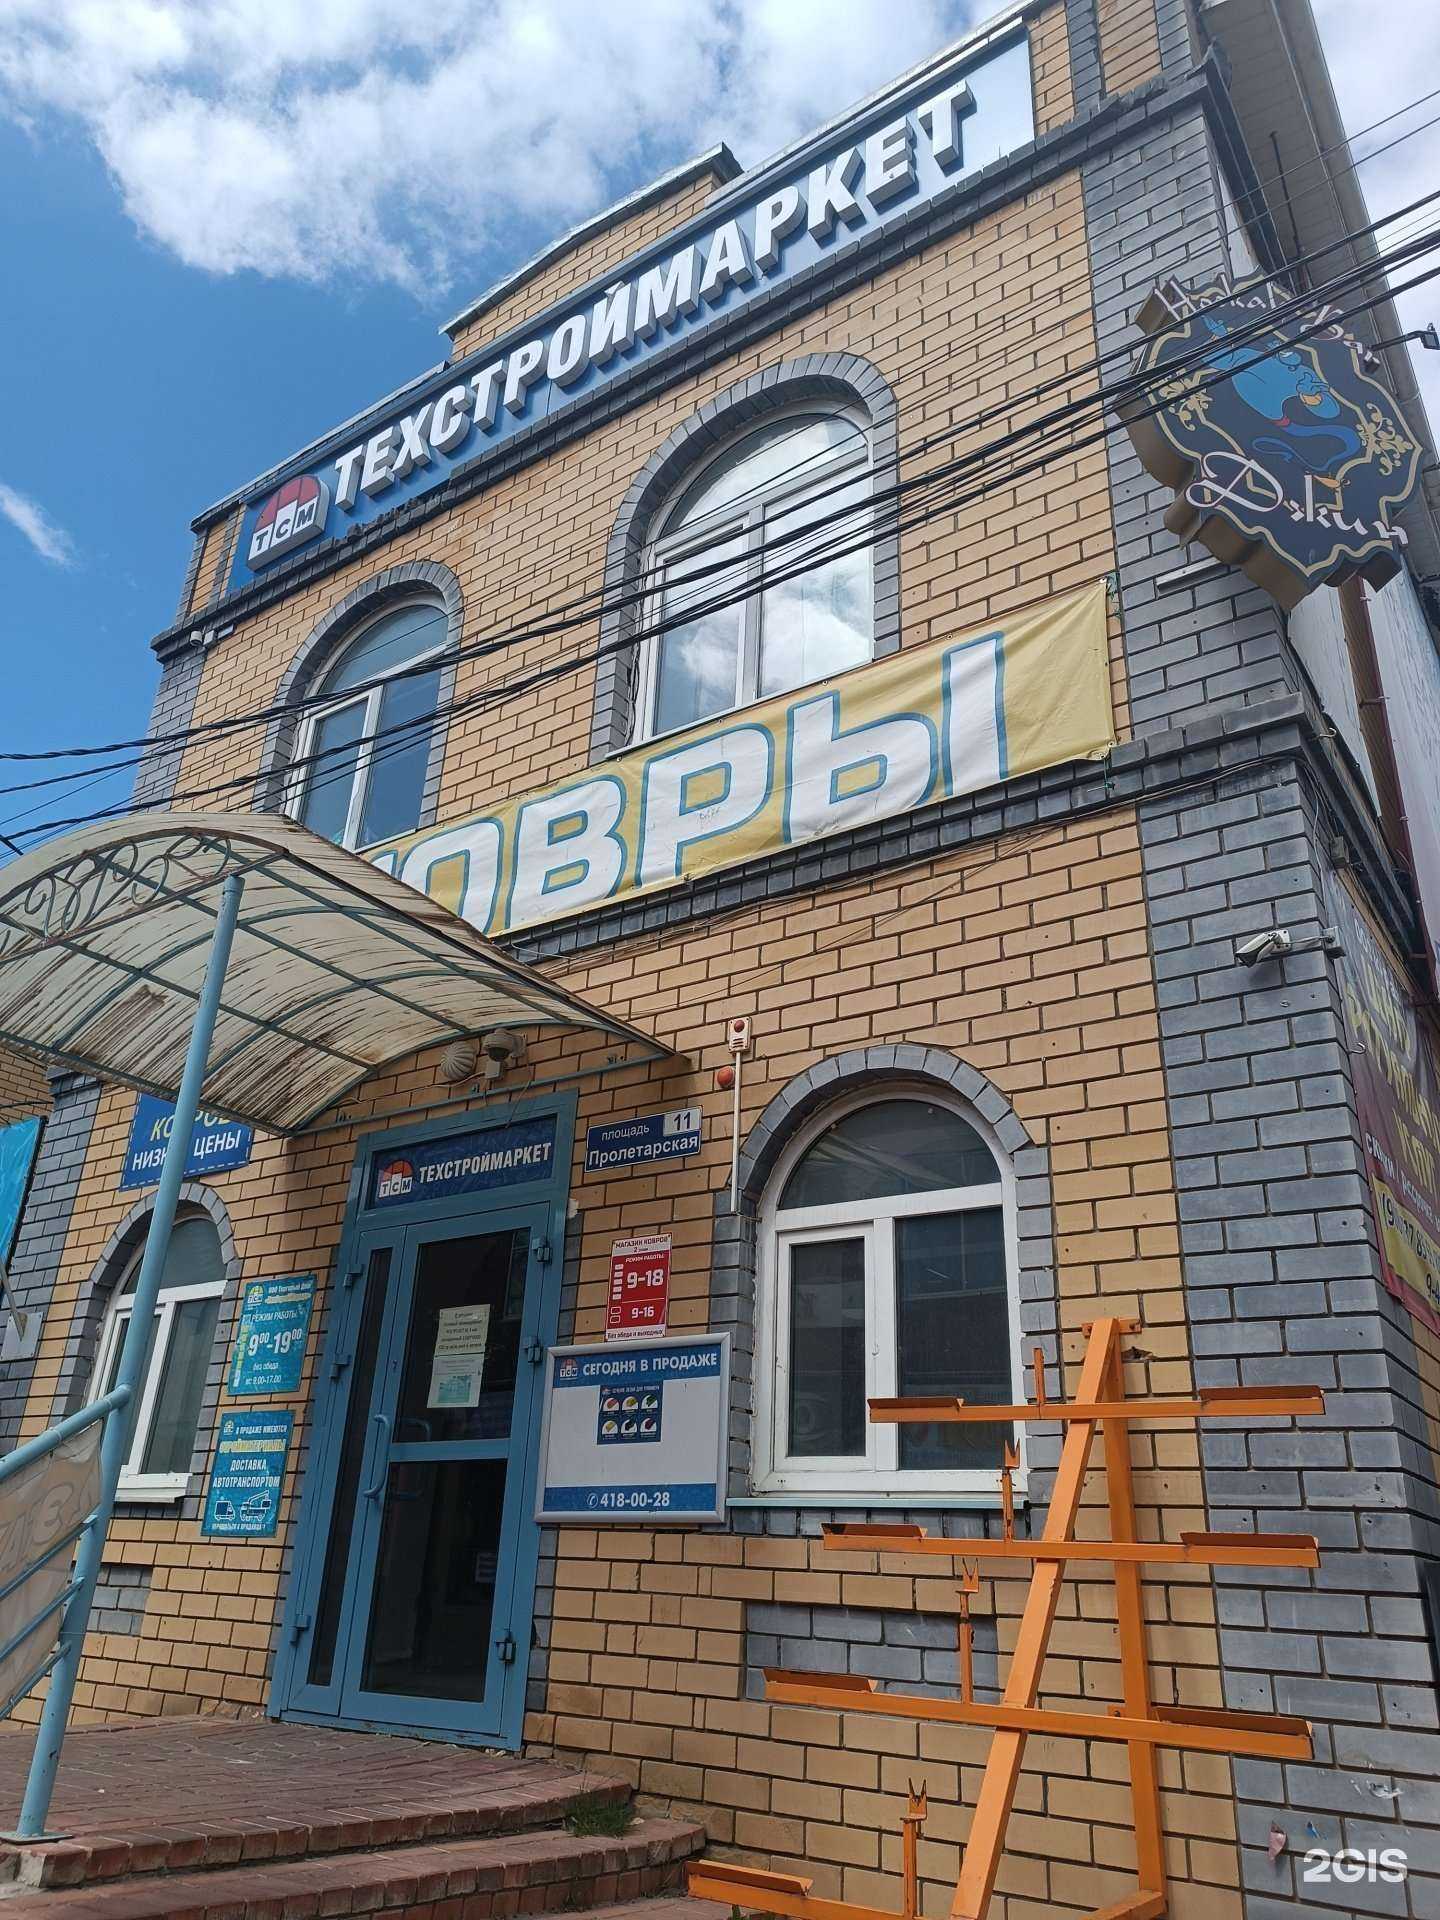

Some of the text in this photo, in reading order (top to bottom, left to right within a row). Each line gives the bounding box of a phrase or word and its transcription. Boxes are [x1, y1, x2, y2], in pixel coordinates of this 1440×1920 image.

[334, 79, 976, 511] ТЕХСТРОЙМАРКЕТ
[252, 498, 319, 556] ТСМ
[370, 630, 1010, 937] ОВРЫ
[600, 1111, 692, 1142] площадь 11
[193, 1129, 242, 1160] ЦЕНЫ
[588, 1134, 699, 1168] Пролетарская
[418, 1142, 552, 1184] ТЕХСТРОЙМАРКЕТ
[380, 1177, 413, 1196] ТСМ
[627, 1268, 664, 1289] 9-18
[252, 1312, 273, 1323] РЕЖИМ
[631, 1306, 655, 1319] 9-16
[582, 1352, 718, 1377] СЕГОДНЯ В ПРОДАЖЕ
[230, 1459, 267, 1472] ДОСТАВКА
[213, 1476, 280, 1488] АВТОТРАНСПОРТОМ
[600, 1491, 671, 1508] 418-00-28
